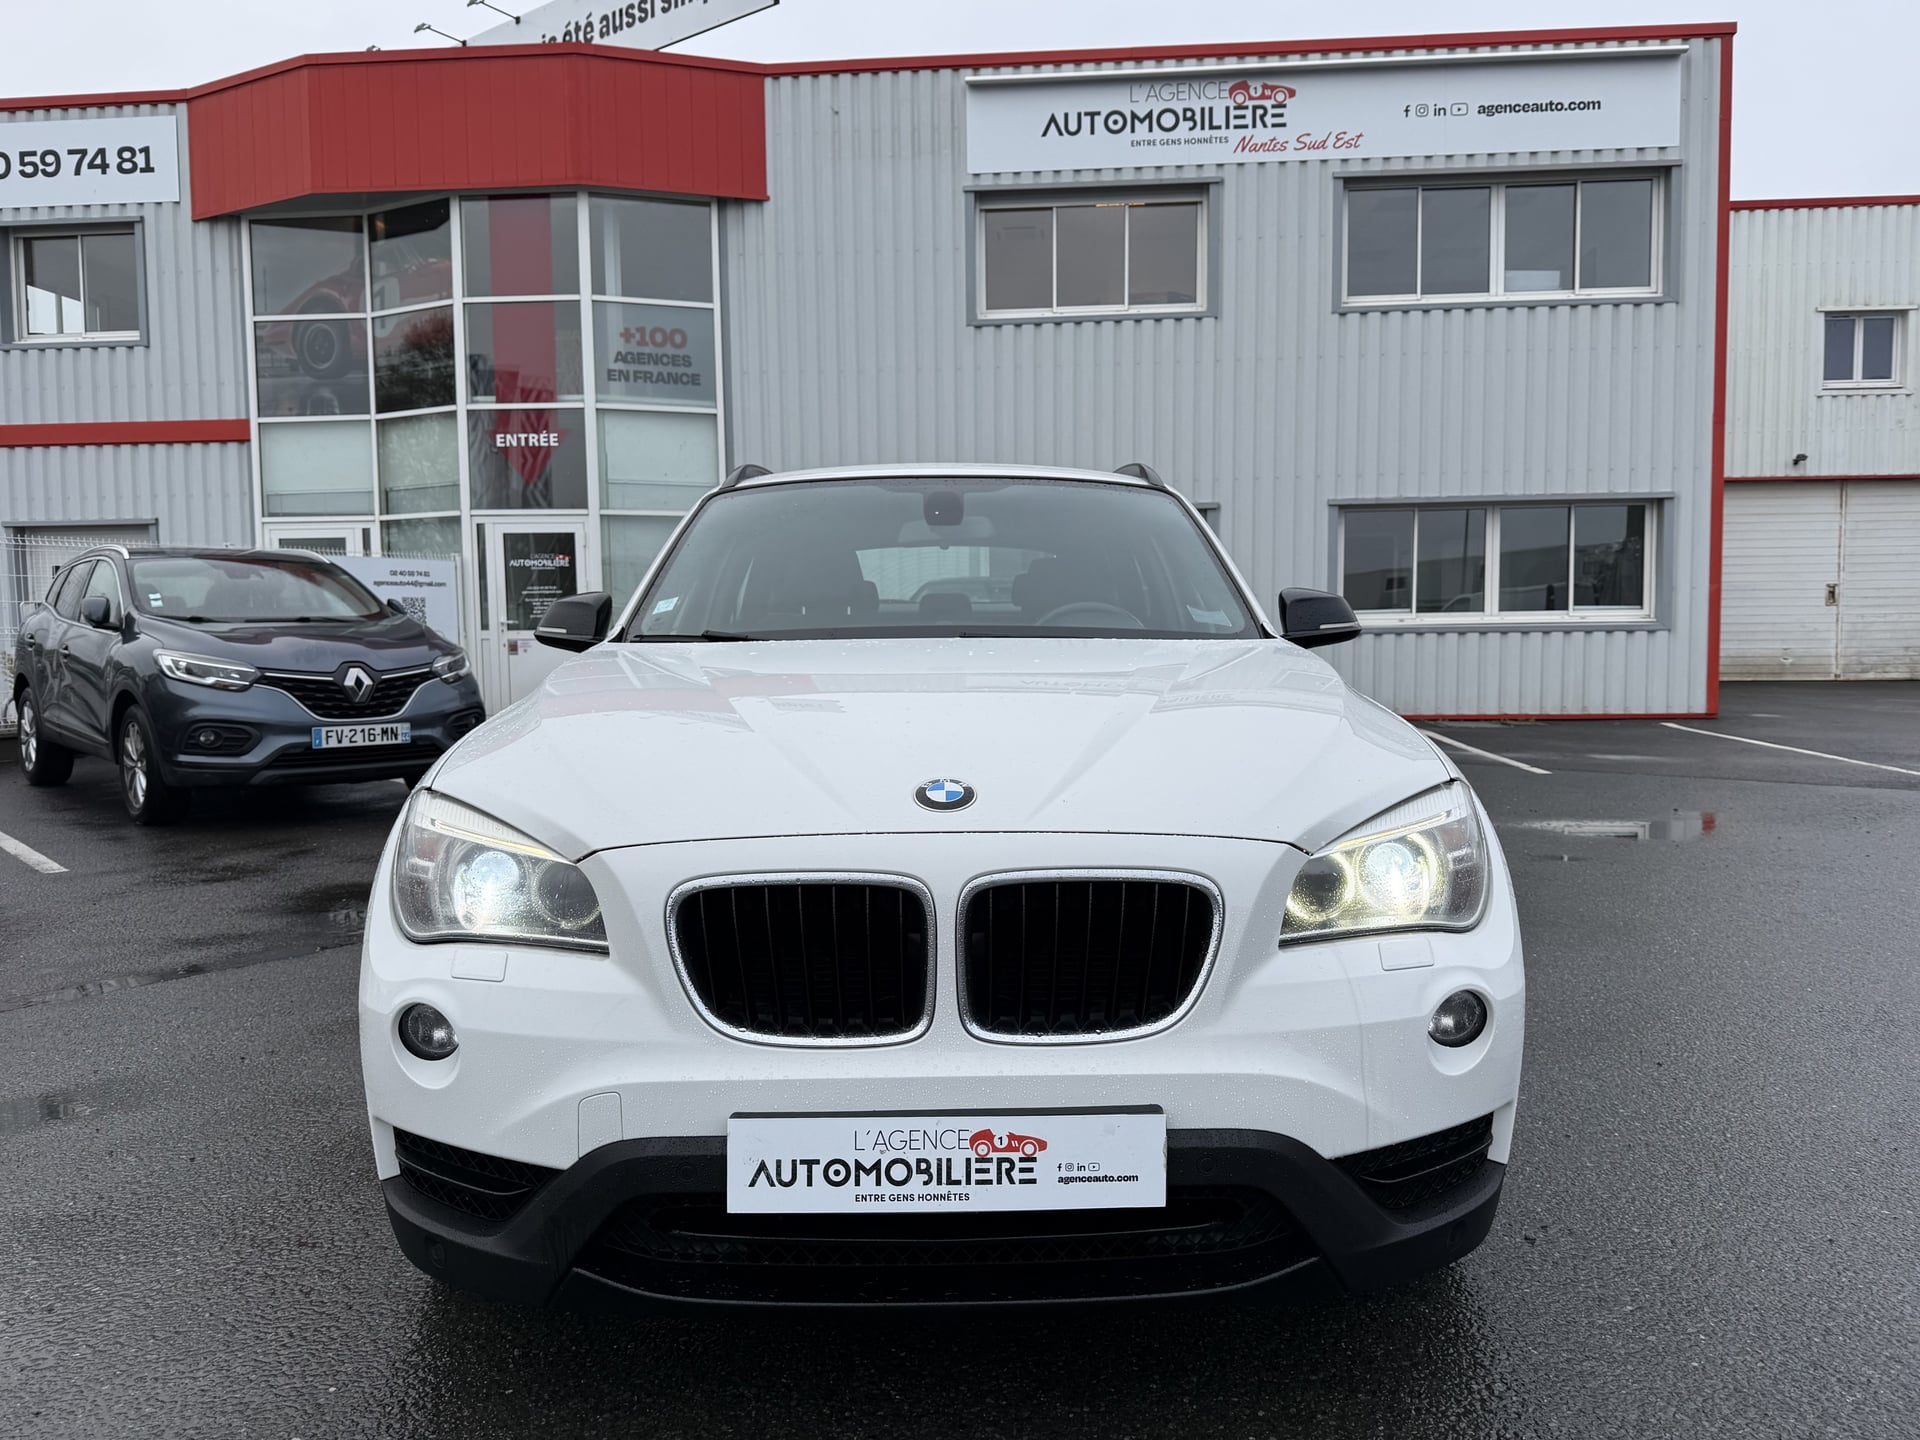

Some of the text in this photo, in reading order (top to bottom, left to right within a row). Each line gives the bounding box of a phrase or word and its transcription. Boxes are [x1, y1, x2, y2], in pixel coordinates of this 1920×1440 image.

[1129, 80, 1230, 103] L'AGENCE
[1477, 99, 1601, 117] agenceauto.com
[1130, 134, 1230, 148] ENTRE GENS HONNÊTES
[1233, 131, 1365, 154] Nantes Sud Est
[18, 148, 62, 179] 59
[66, 147, 110, 177] 74
[116, 145, 155, 175] 81
[619, 325, 688, 350] +100
[613, 350, 693, 368] AGENCES
[607, 367, 702, 386] EN FRANCE
[495, 430, 559, 447] ENTRÉE
[325, 726, 399, 745] FV-216-MN
[854, 1129, 970, 1151] L'AGENCE
[1057, 1173, 1139, 1185] agenceauto.com
[855, 1191, 970, 1203] ENTRE GENS HONNÊTES
